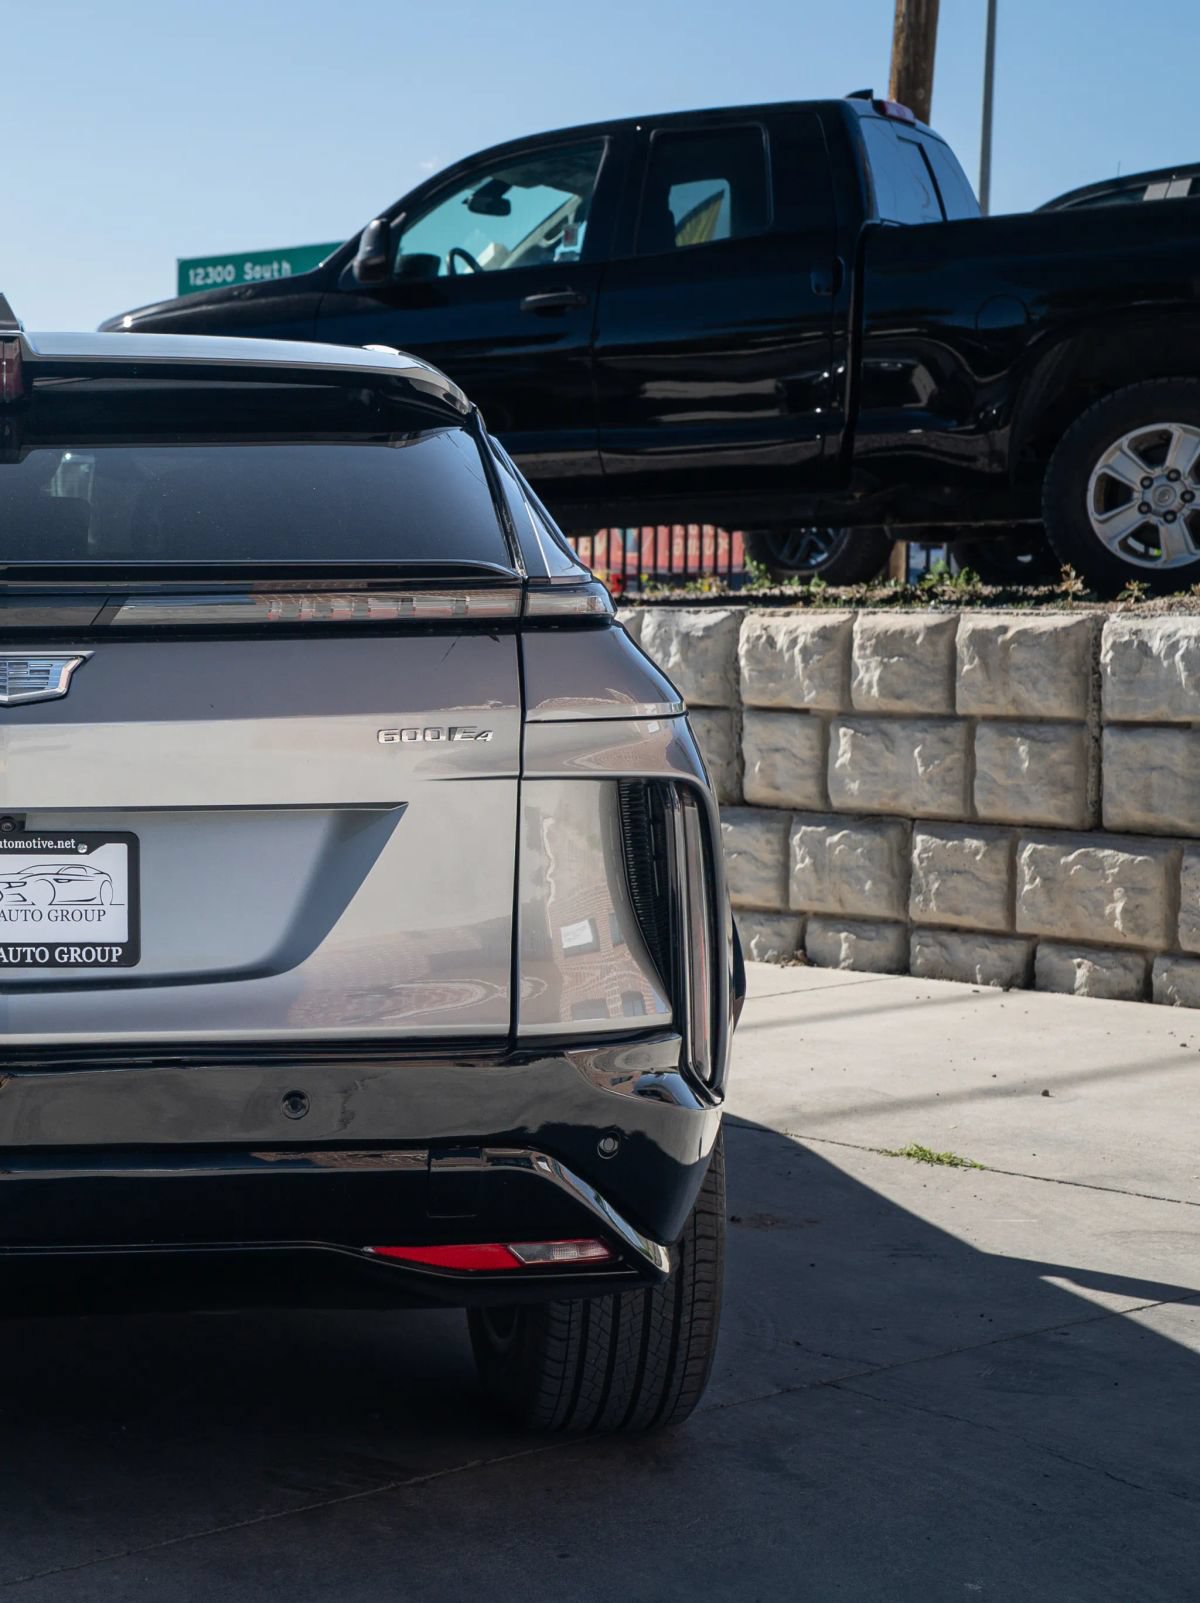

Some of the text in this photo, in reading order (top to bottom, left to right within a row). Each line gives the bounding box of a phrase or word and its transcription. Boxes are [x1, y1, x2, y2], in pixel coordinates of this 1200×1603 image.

[189, 260, 291, 286] 12300 South
[47, 909, 106, 922] GROUP
[54, 946, 123, 963] GROUP
